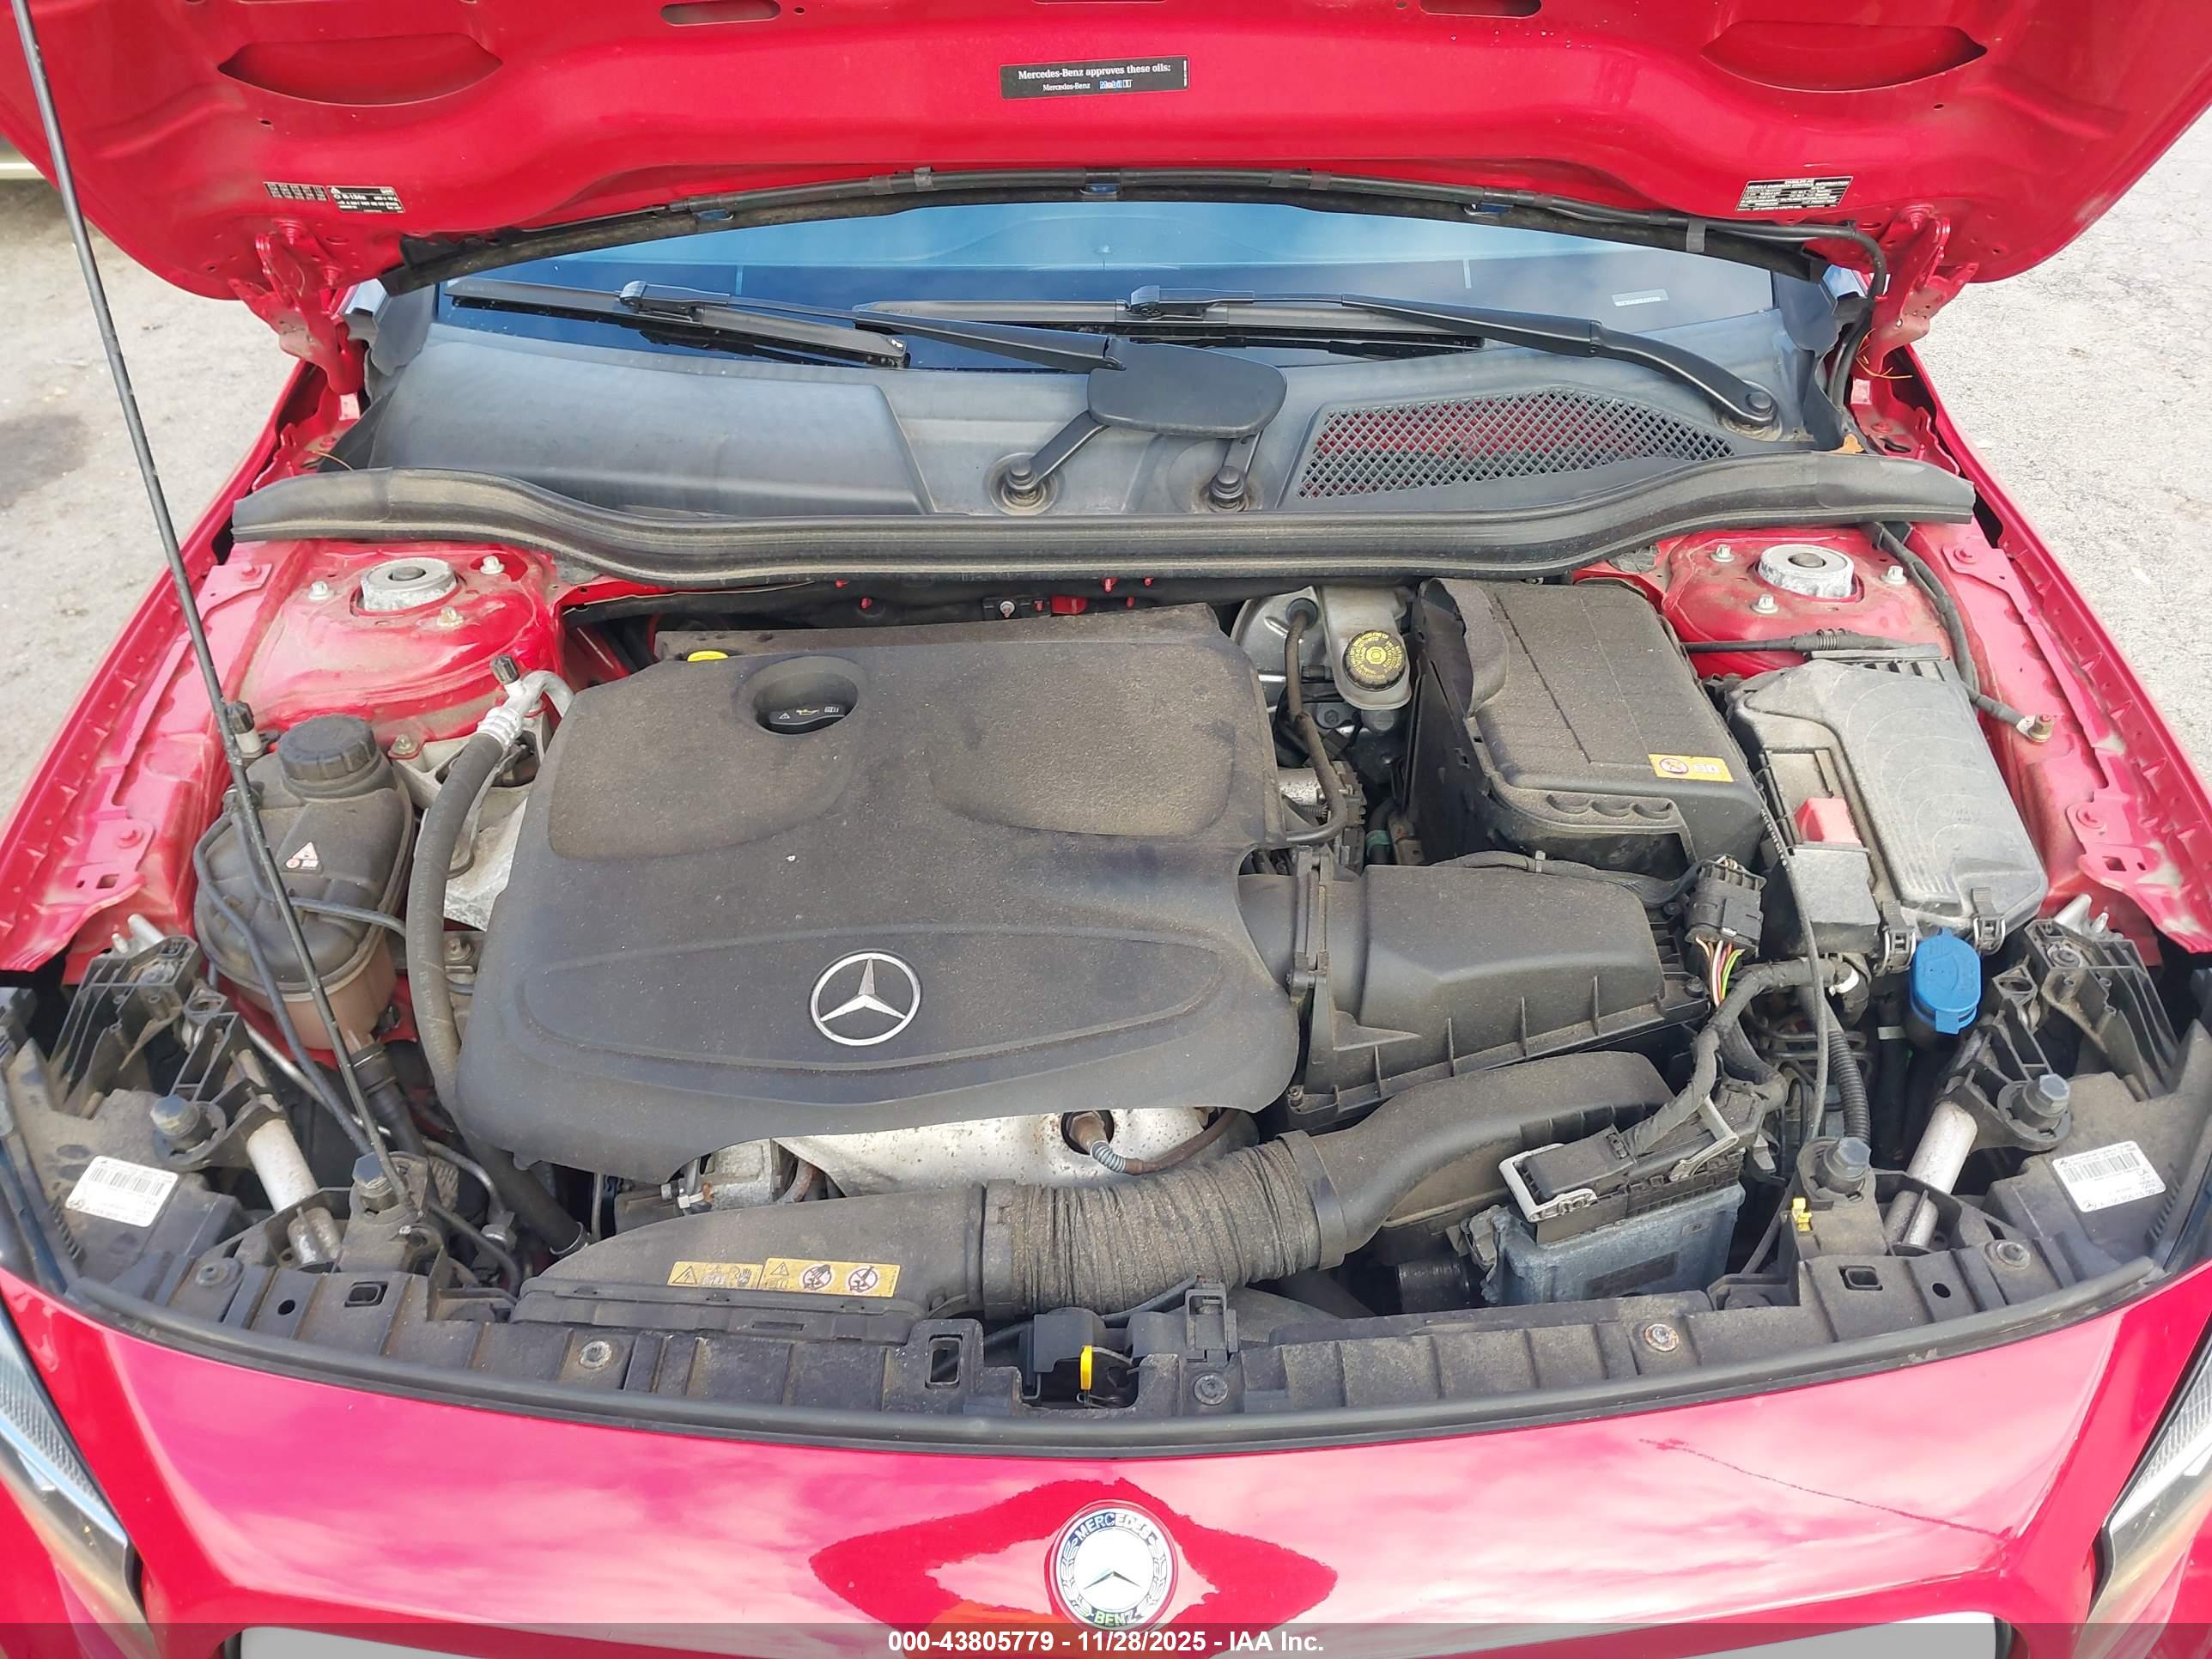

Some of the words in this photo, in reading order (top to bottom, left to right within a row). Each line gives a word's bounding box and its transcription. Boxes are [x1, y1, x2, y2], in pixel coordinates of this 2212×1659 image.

[1018, 68, 1085, 80] Mercedes-Benz
[1085, 66, 1125, 78] approves
[1126, 64, 1152, 74] these
[1152, 63, 1171, 72] oils:
[1042, 82, 1091, 91] Mercedes-Benz
[1077, 1512, 1151, 1540] MERCEDES
[1093, 1609, 1137, 1625] BENZ
